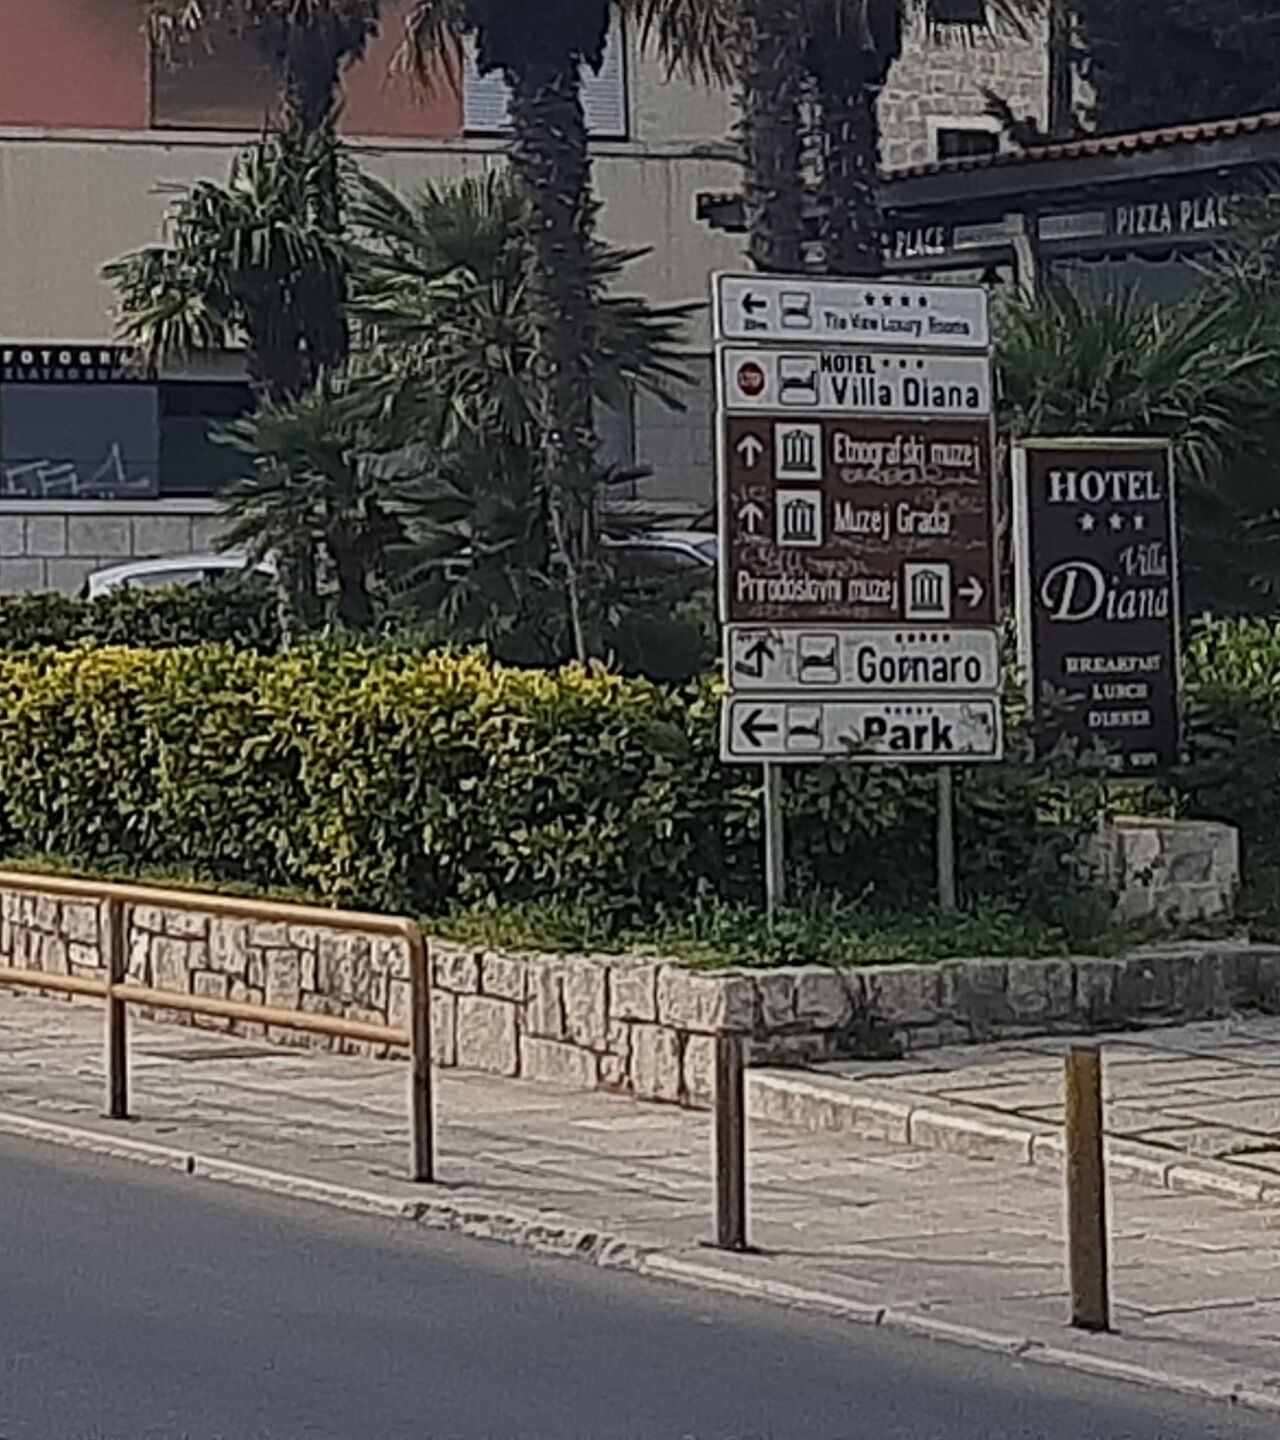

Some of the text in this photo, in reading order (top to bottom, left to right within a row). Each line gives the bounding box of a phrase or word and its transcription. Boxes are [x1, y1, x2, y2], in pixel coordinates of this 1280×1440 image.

[1116, 203, 1171, 234] PIZZA
[820, 354, 876, 375] HOTEL
[831, 376, 980, 408] Villa Diana
[930, 436, 981, 474] muzej
[1048, 470, 1162, 502] HOTEL
[834, 501, 951, 541] Muzej Grada
[847, 571, 900, 610] muzej
[1041, 561, 1169, 620] Diana
[863, 715, 953, 751] Park
